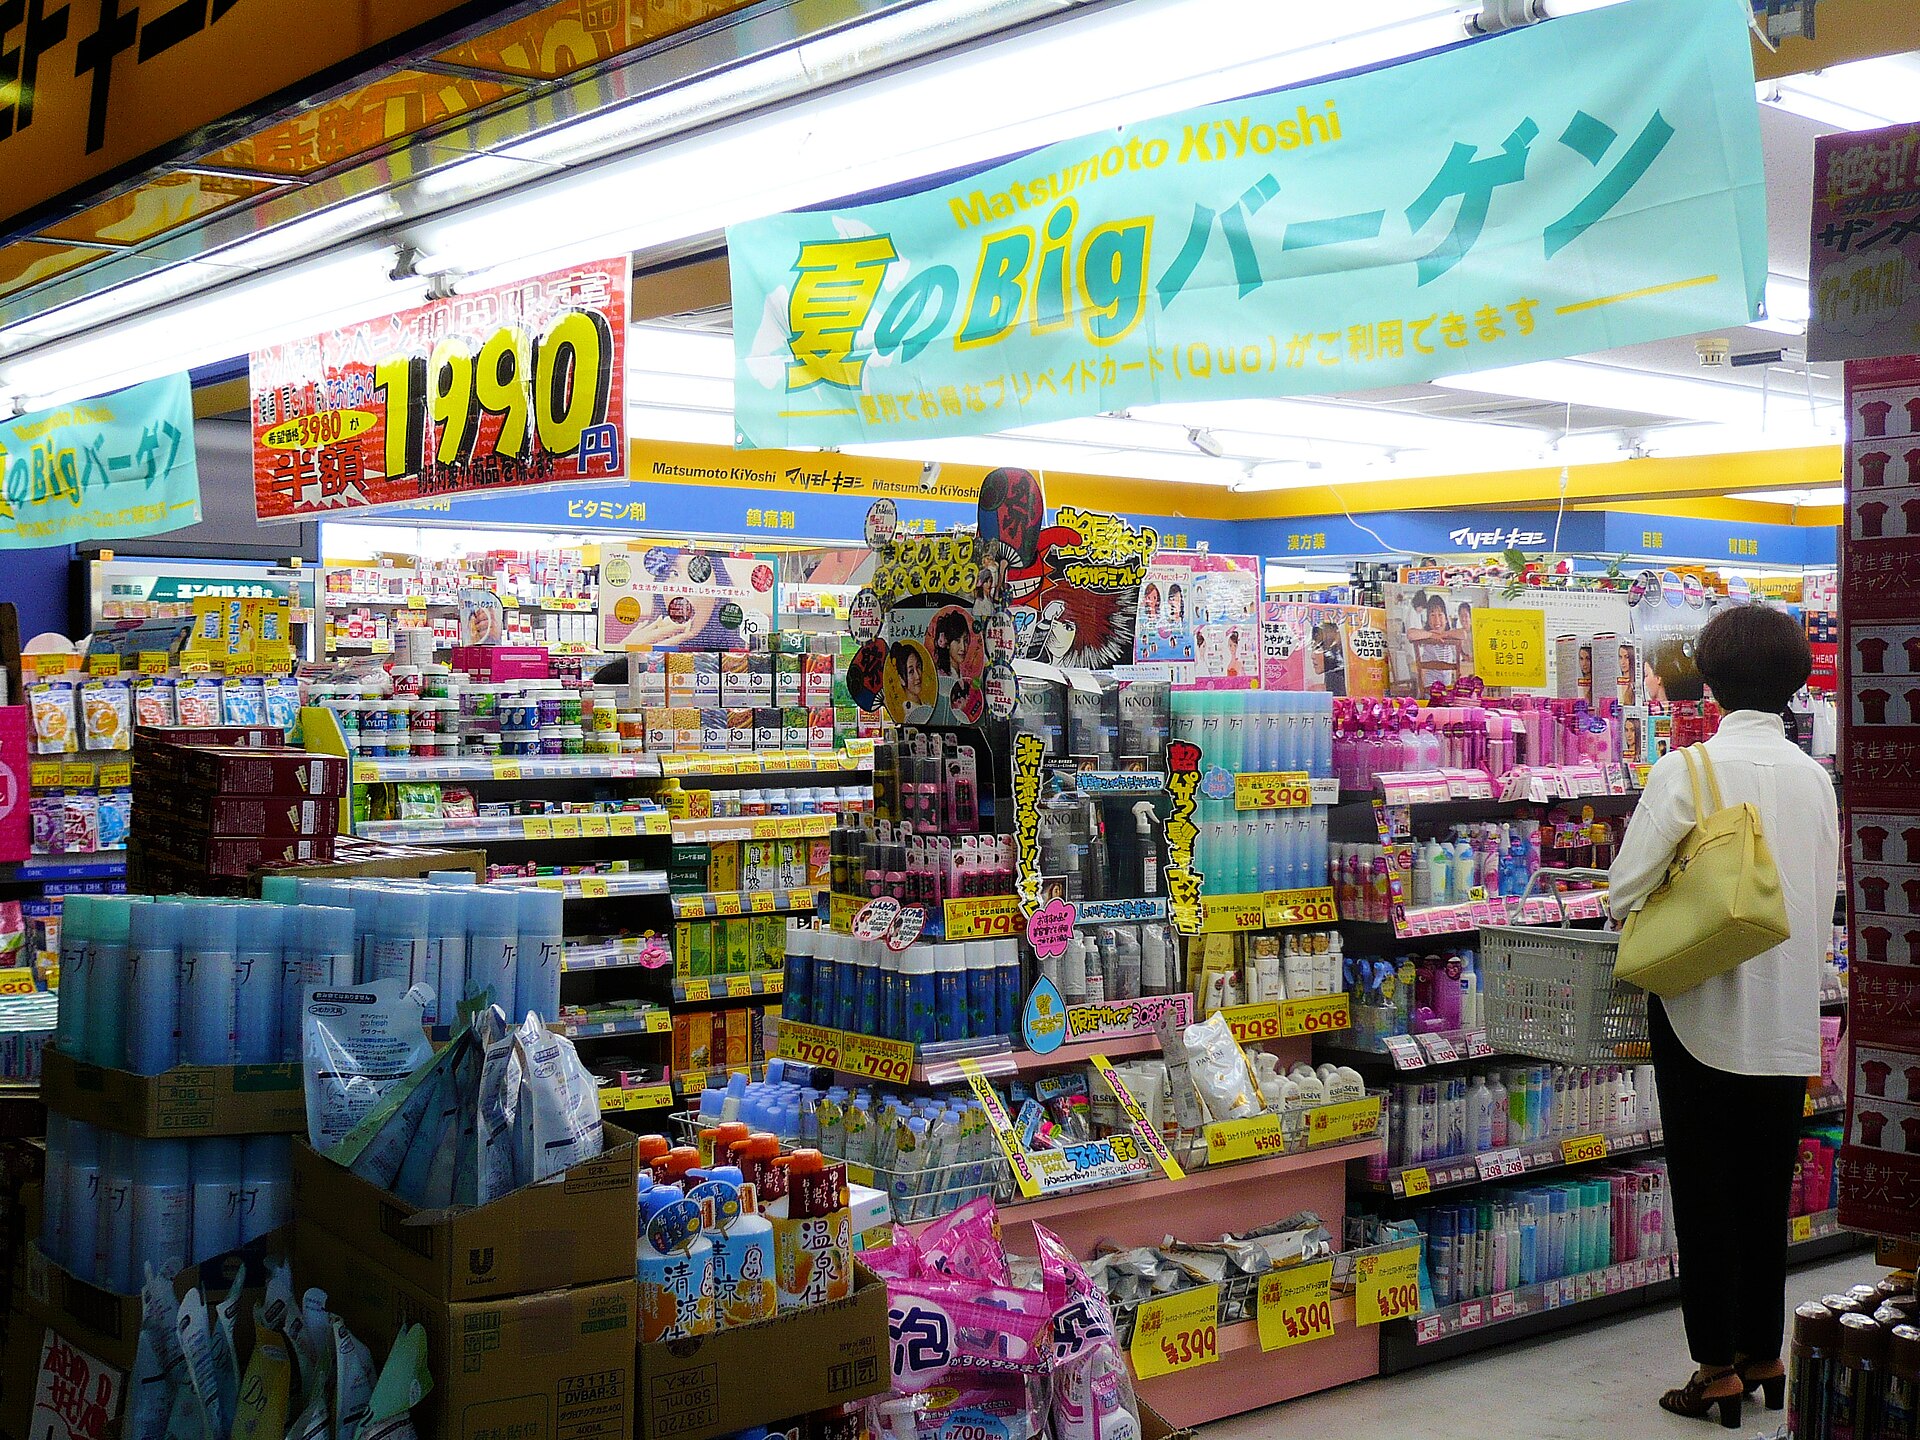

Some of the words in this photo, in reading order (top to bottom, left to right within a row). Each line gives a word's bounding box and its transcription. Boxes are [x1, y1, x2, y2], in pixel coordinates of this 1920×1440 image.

[948, 137, 1168, 230] Matsumoto
[1176, 100, 1343, 166] KiYoshi
[374, 307, 615, 482] 1990
[577, 423, 618, 474] 円
[272, 440, 368, 503] 半額
[652, 462, 728, 480] Matsumoto
[730, 468, 777, 484] KiYoshi
[785, 467, 865, 491] マツモトキヨシ
[939, 484, 980, 499] KiYoshi
[568, 500, 646, 522] ビタミン剤
[746, 508, 795, 529] 鎮痛剤
[1287, 533, 1326, 551] 漢方薬
[1488, 637, 1529, 650] 暮らしの
[1494, 652, 1525, 665] 記念日
[1815, 654, 1834, 664] HEAD
[1260, 788, 1307, 806] 399
[1288, 903, 1333, 922] 399
[974, 914, 1028, 935] 798
[1231, 1018, 1278, 1040] 798
[1304, 1009, 1348, 1031] 698
[797, 1040, 841, 1068] 799
[863, 1054, 909, 1083] 799
[1578, 1145, 1602, 1159] 698
[1376, 1283, 1419, 1317] ¥399
[1282, 1300, 1331, 1339] ¥399
[889, 1306, 951, 1376] 泡
[1161, 1325, 1217, 1366] ¥399
